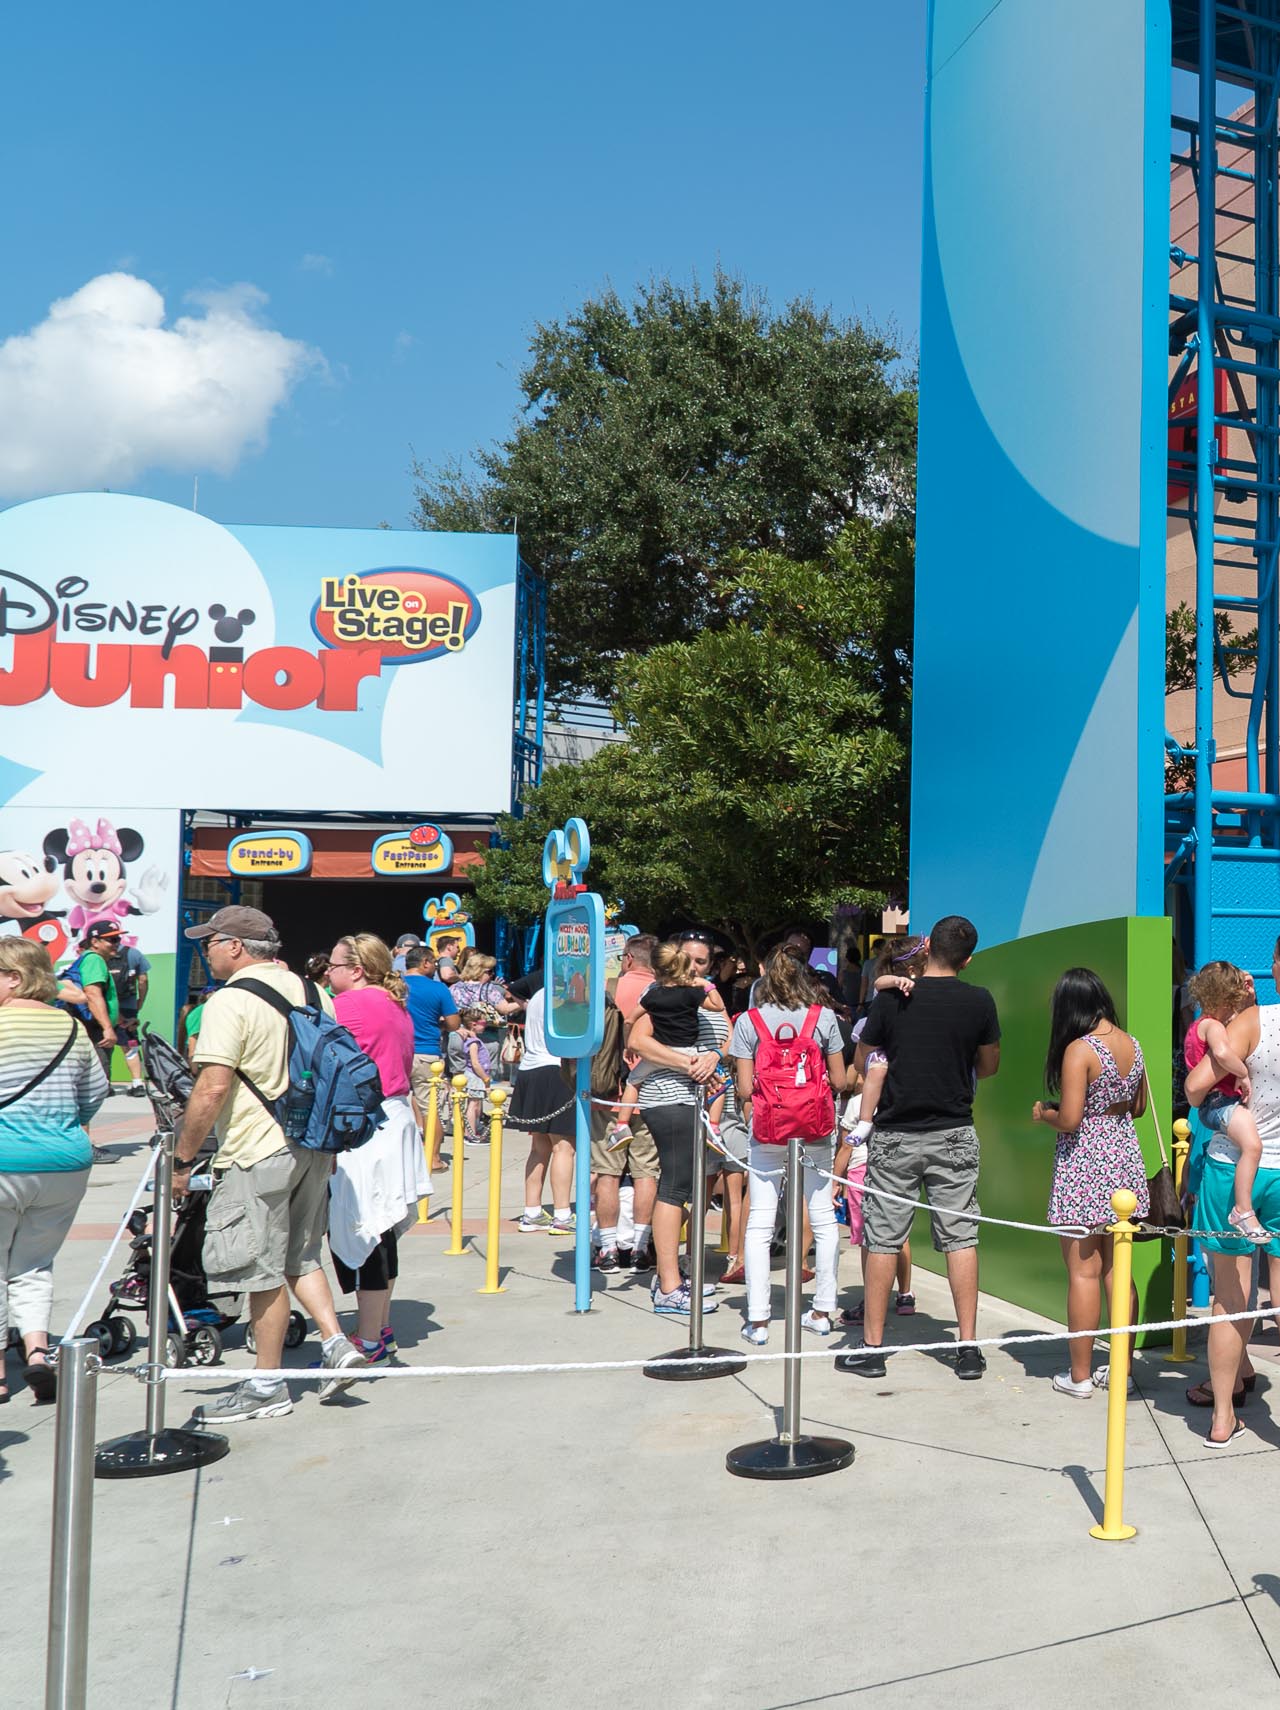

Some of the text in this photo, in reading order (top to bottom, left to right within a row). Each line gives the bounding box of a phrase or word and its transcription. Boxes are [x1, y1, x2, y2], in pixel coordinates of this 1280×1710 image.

[325, 577, 420, 611] Live on
[338, 605, 464, 647] Stage!
[0, 622, 381, 712] Junior
[238, 848, 293, 861] Stand-by
